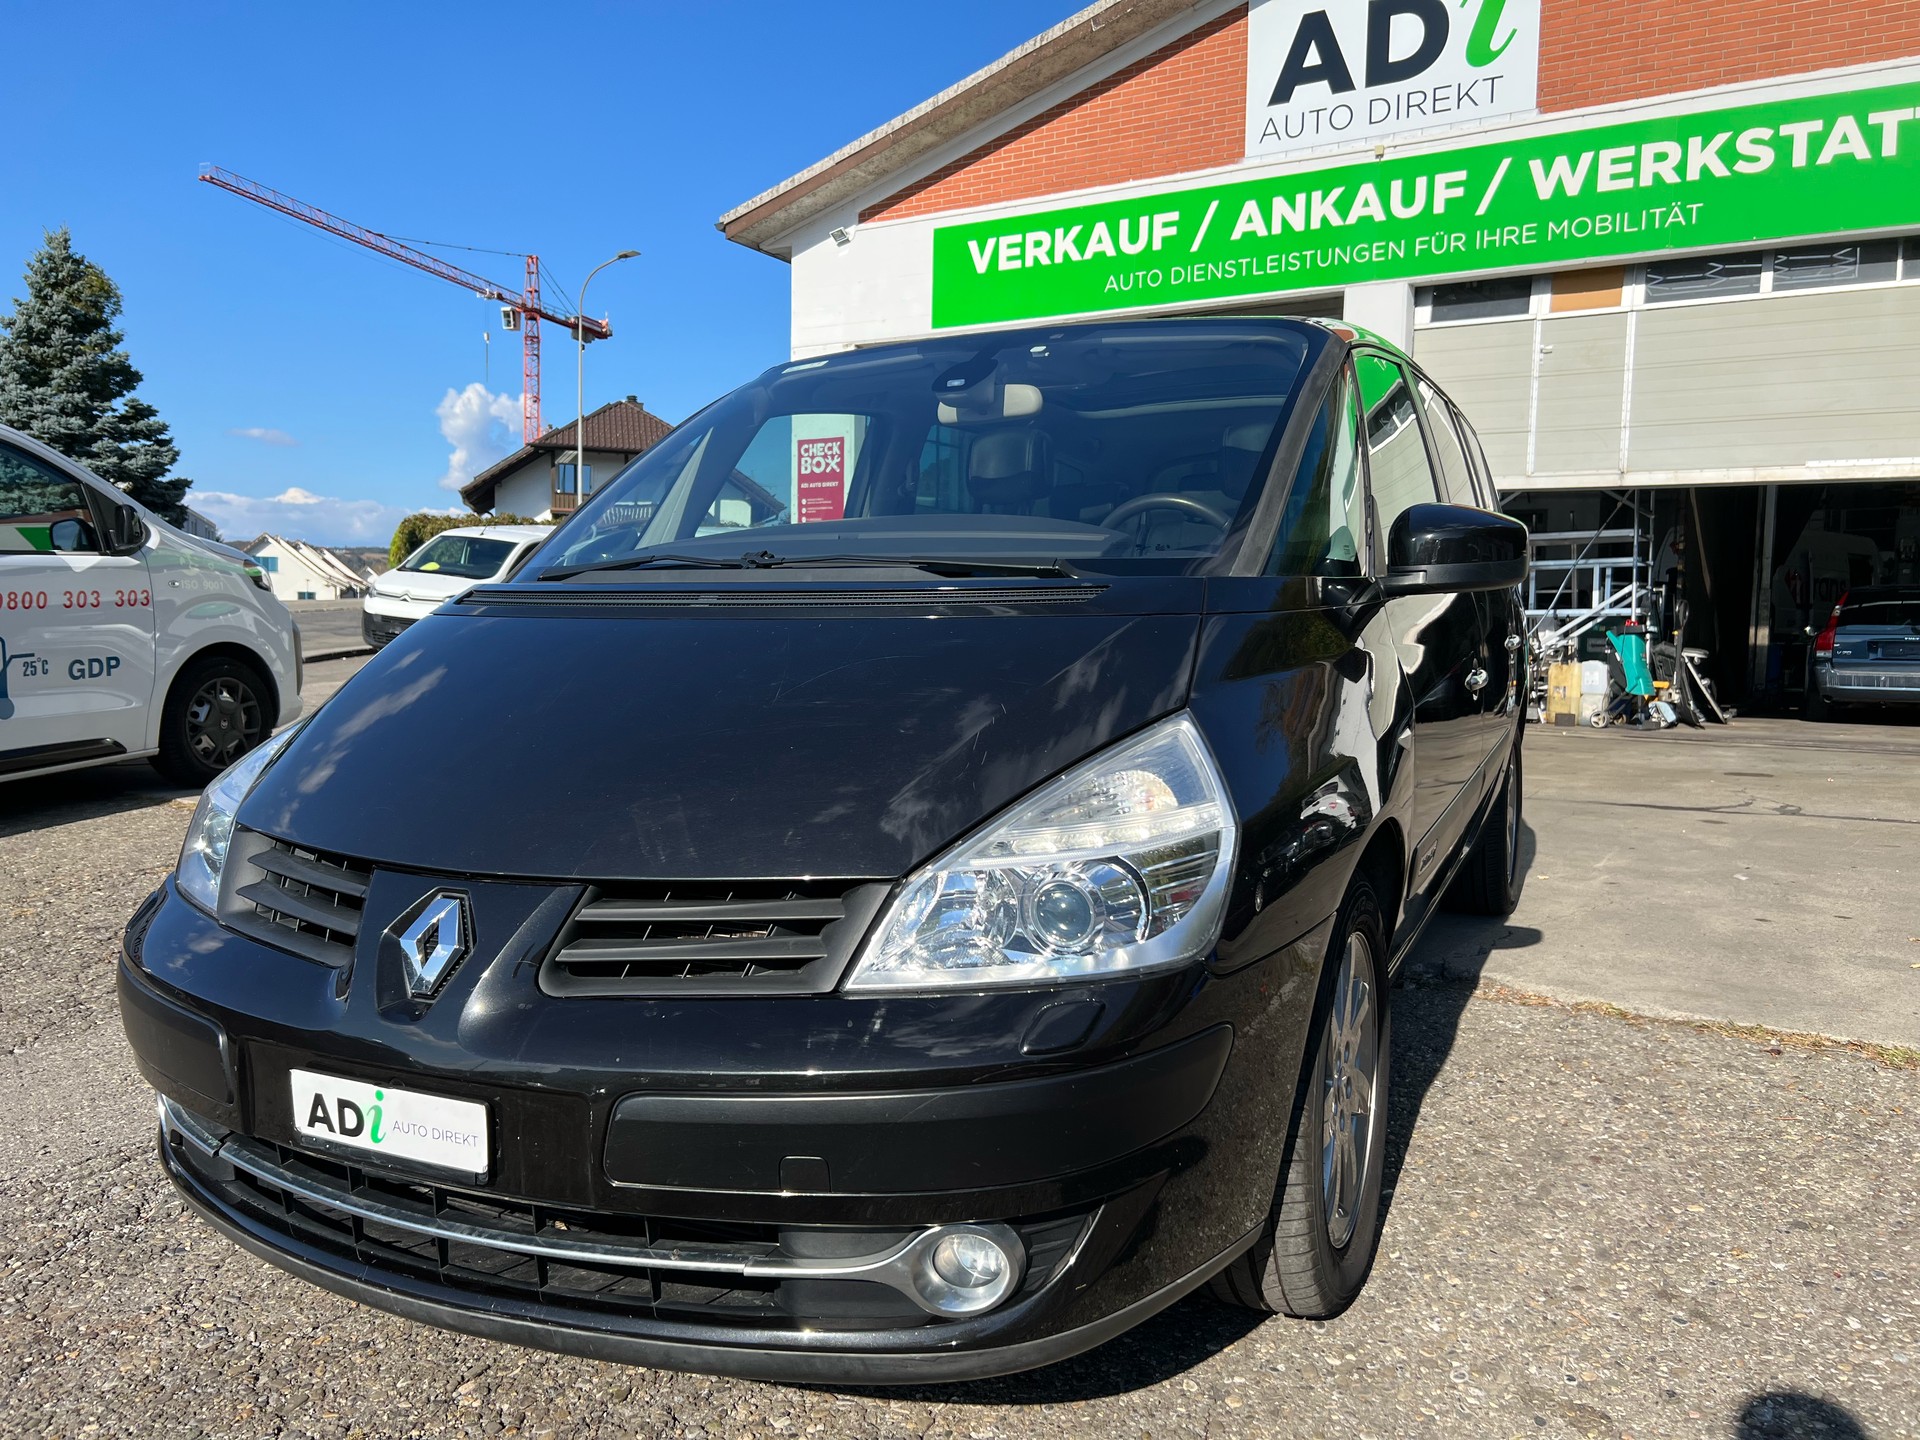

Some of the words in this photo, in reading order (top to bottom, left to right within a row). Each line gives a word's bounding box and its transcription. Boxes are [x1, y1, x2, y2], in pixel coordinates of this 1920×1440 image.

[1259, 104, 1354, 144] AUTO
[1368, 75, 1504, 125] DIREKT
[967, 211, 1180, 274] VERKAUF
[1230, 170, 1467, 240] ANKAUF
[1528, 105, 1920, 200] WERKSTAT
[1104, 269, 1163, 293] AUTO
[1171, 239, 1405, 286] DIENSTLEISTUNGEN
[1415, 231, 1466, 257] FÜR
[1476, 223, 1538, 249] IHRE
[1548, 201, 1704, 241] MOBILITÄT
[800, 442, 841, 457] CHECK
[800, 454, 841, 474] BOX
[0, 591, 48, 610] 800
[63, 590, 101, 609] 303
[115, 589, 150, 608] 303
[68, 656, 121, 680] GDP
[307, 1089, 386, 1144] ADi
[392, 1120, 428, 1138] AUTO
[432, 1128, 479, 1147] DIREKT
